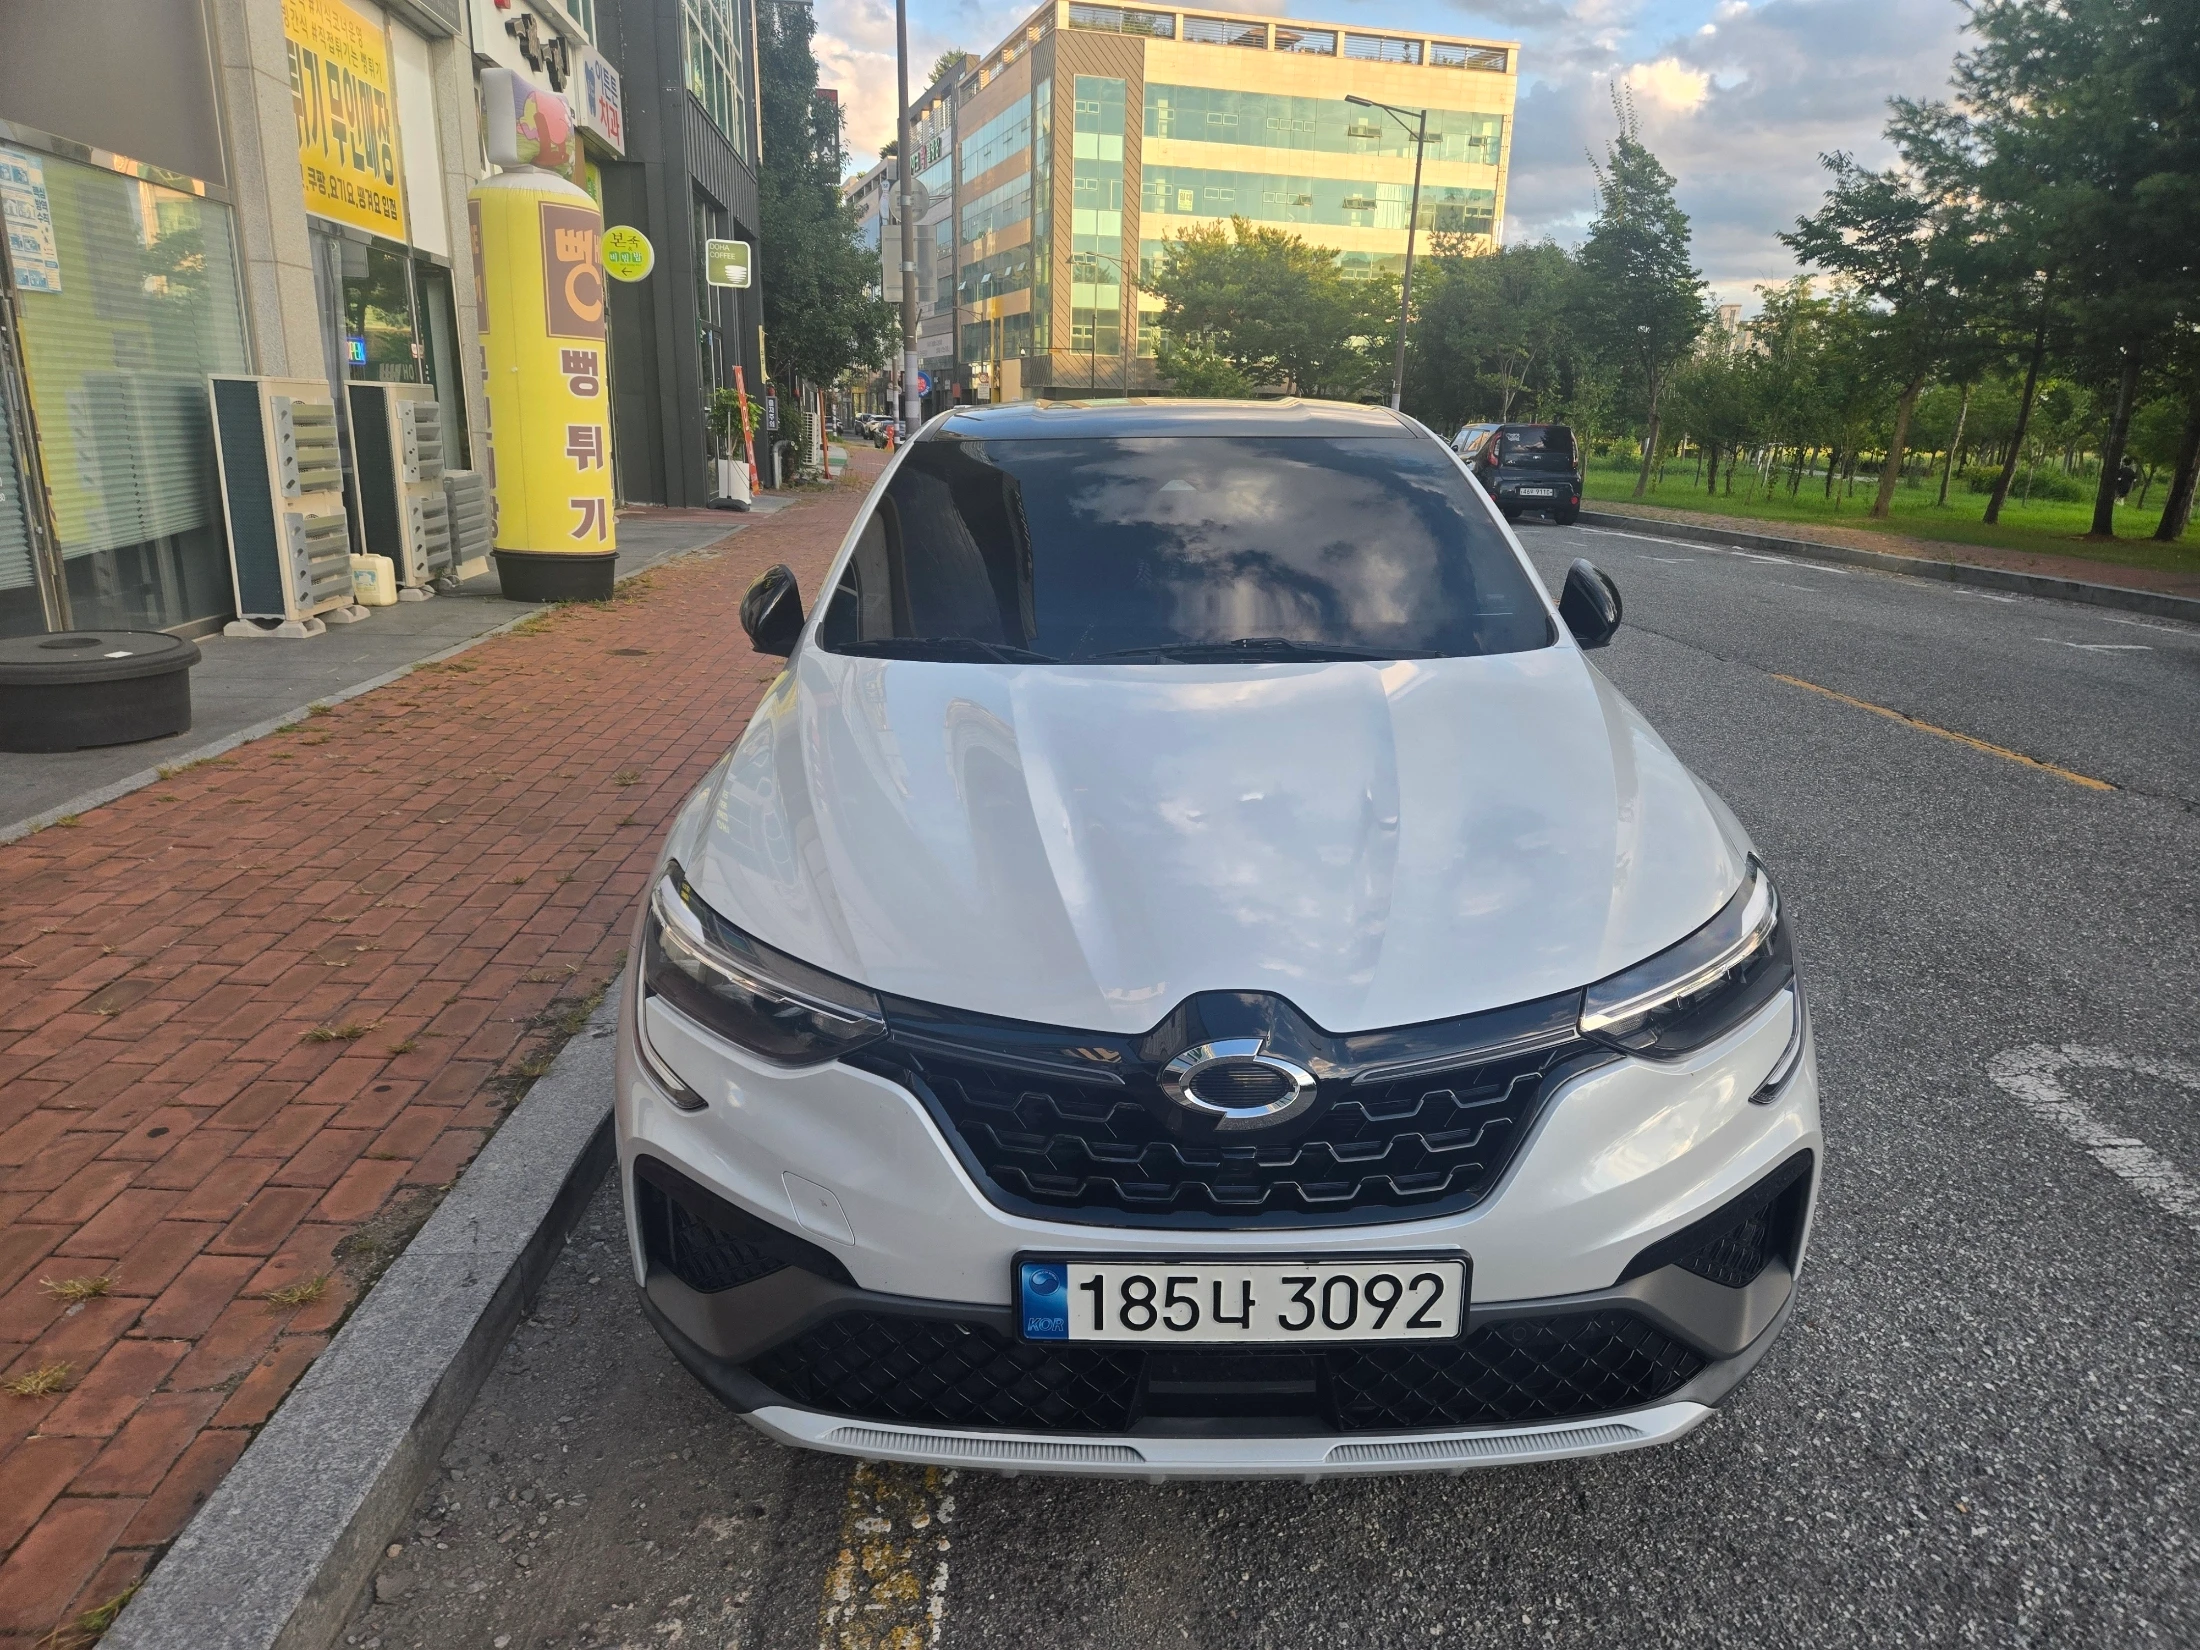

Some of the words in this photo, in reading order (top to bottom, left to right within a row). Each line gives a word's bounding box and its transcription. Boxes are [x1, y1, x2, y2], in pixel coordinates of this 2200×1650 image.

[594, 60, 618, 108] 이튼튼
[325, 59, 394, 187] 무인매장
[599, 96, 620, 146] 치과
[610, 232, 640, 248] 본죽
[709, 243, 729, 251] DOHA
[709, 252, 735, 260] COFFEE
[609, 251, 642, 262] 비빔밥
[561, 350, 607, 542] 뻥튀기
[1080, 1274, 1255, 1332] 185나
[1278, 1273, 1444, 1331] 3092
[1028, 1318, 1064, 1331] KOR
